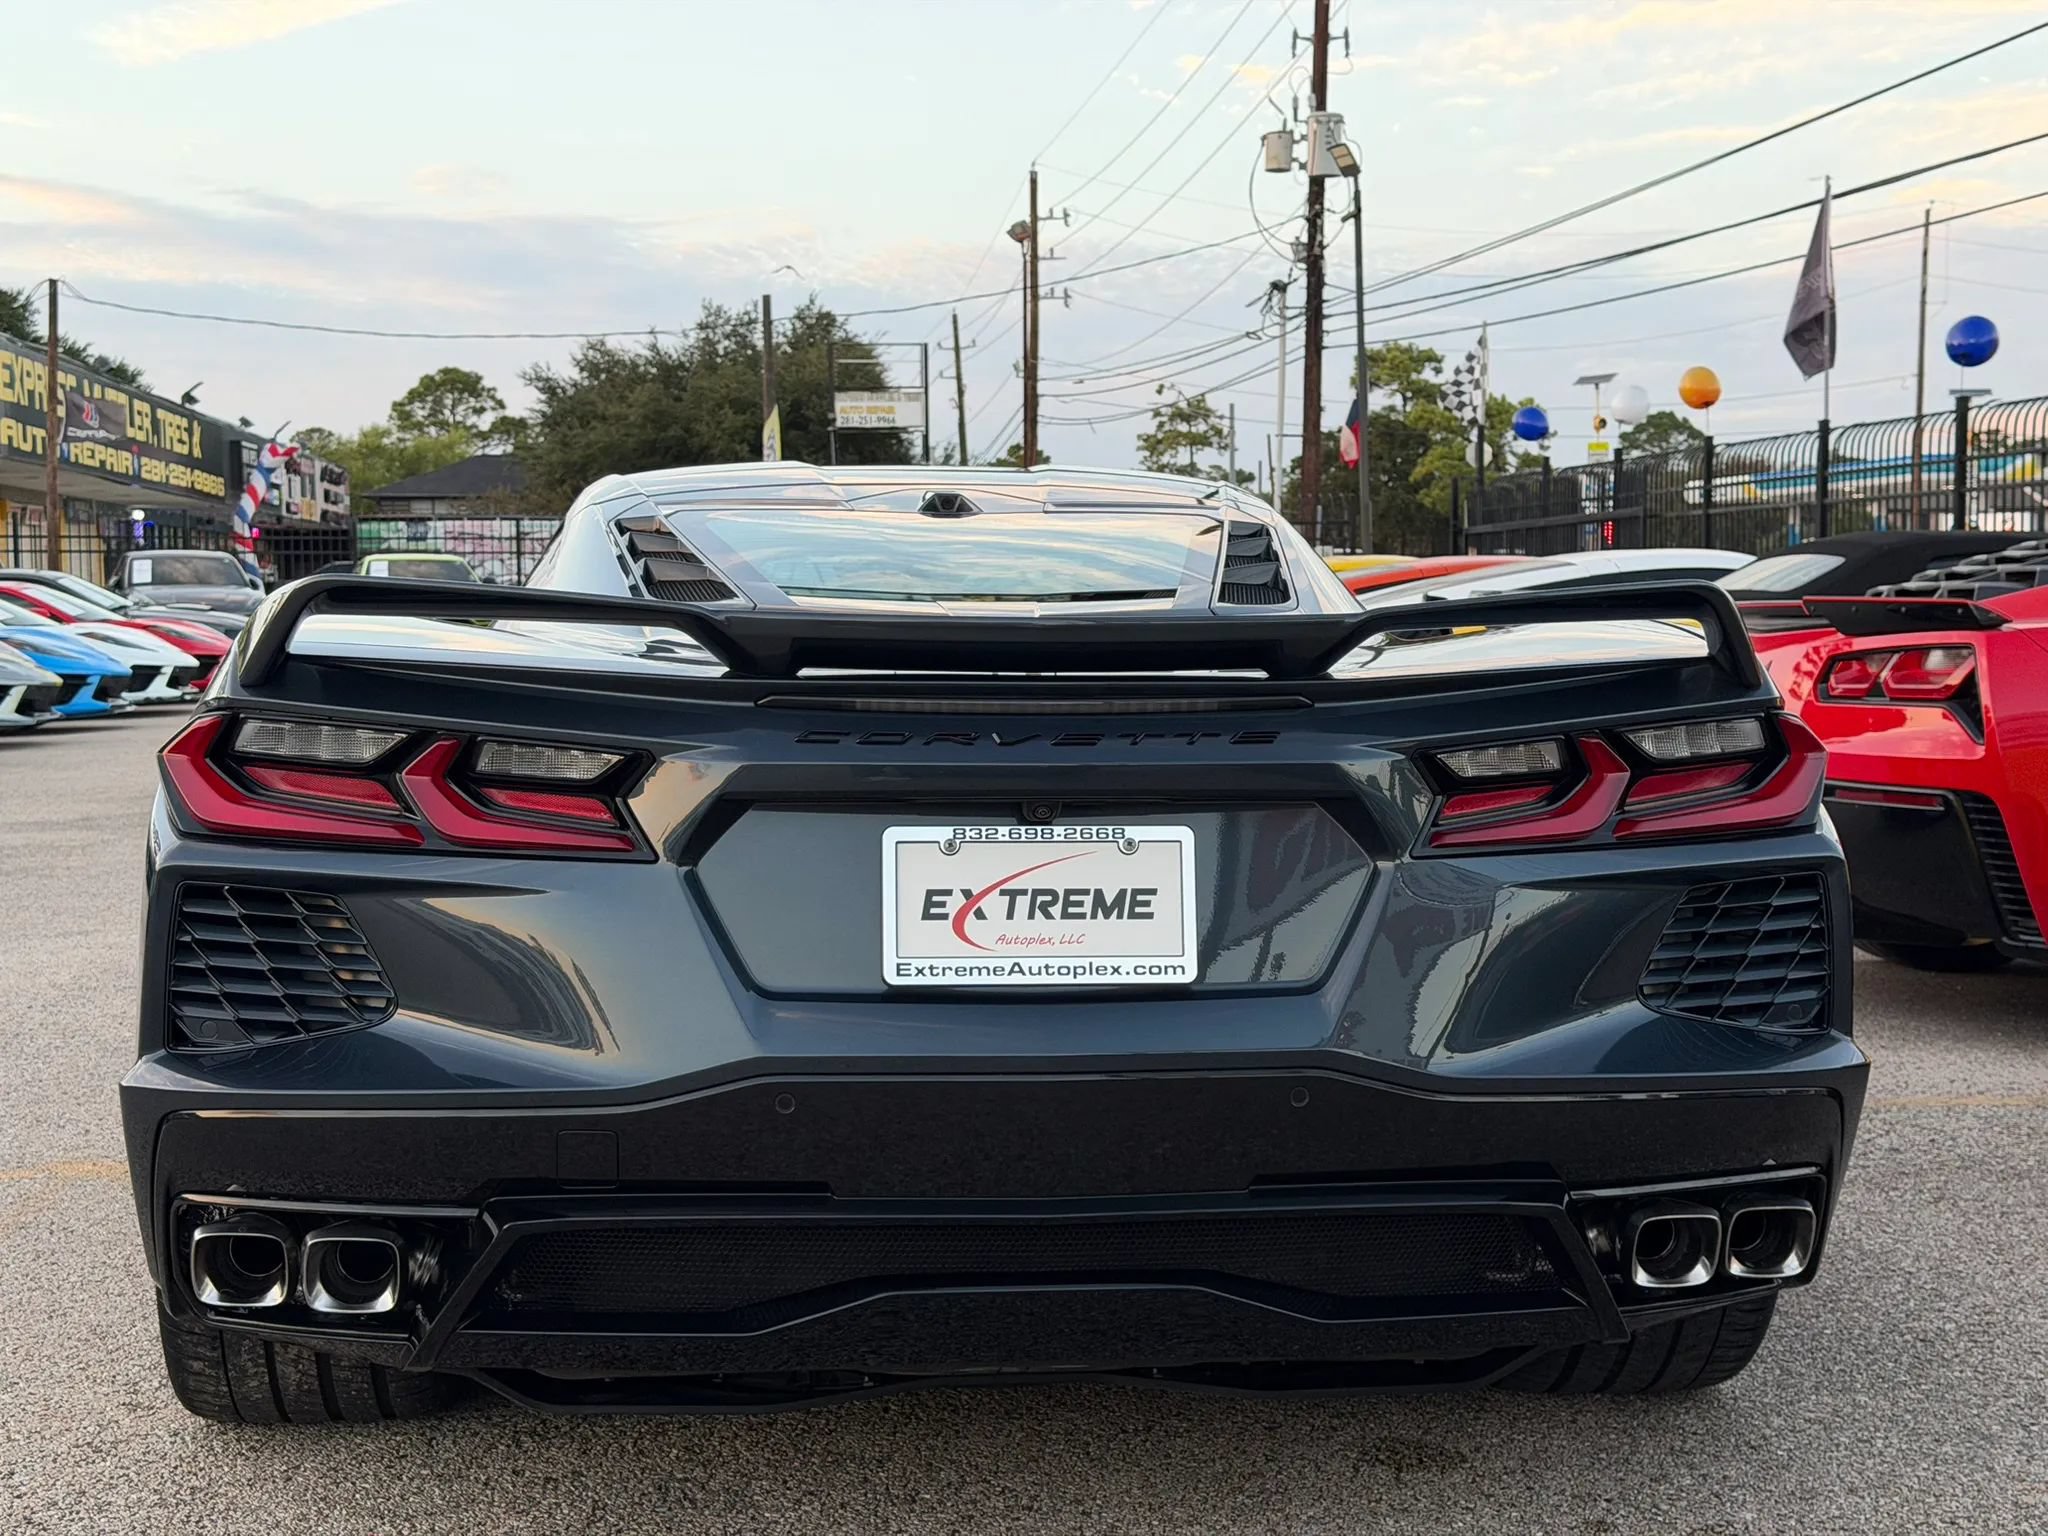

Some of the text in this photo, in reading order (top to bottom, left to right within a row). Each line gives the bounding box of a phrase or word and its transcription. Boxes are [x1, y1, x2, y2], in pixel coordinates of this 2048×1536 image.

[0, 416, 60, 458] AUT
[69, 441, 133, 476] REPAIR
[793, 729, 1281, 747] CORVETTE
[952, 827, 1127, 840] 832-698-2668
[920, 888, 1159, 921] EXTREME
[995, 932, 1086, 948] Autoplex, LLC
[895, 961, 1186, 979] ExtremeAutoplex.com
